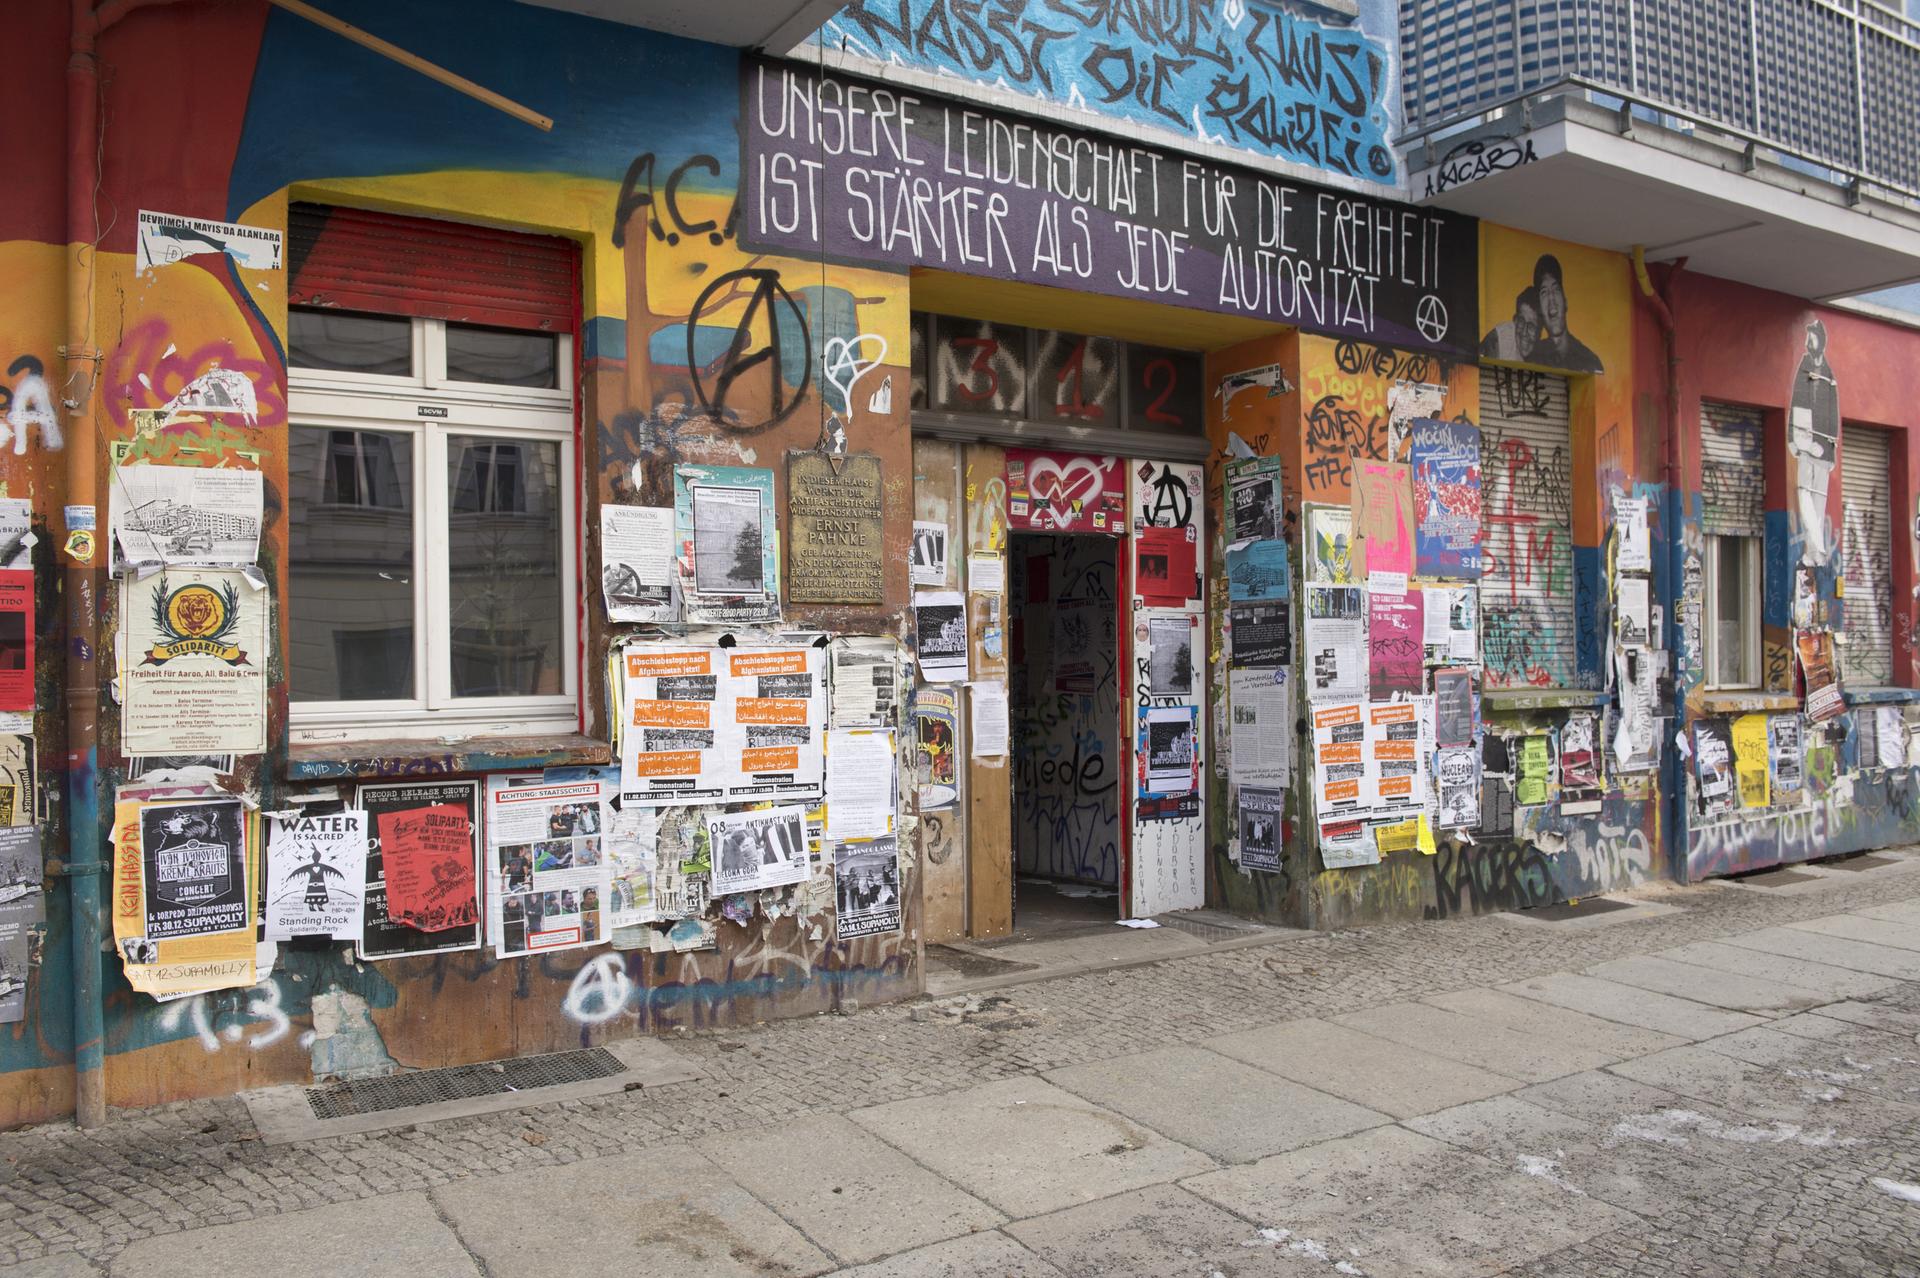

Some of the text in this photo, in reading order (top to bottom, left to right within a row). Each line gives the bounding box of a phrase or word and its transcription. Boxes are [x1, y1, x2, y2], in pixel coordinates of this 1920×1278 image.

[758, 65, 1446, 290] UNSERE LEIDENSCHAFT FÜR DIE FREIHEIT
[236, 226, 280, 242] ALANLARA
[759, 152, 1380, 335] IST STÄRKER ALS JEDE AUTORITÄT
[1143, 358, 1184, 425] 2
[797, 475, 807, 485] IN
[844, 477, 873, 487] HAUSE
[816, 519, 859, 532] ERNST
[808, 532, 866, 546] PAHNKE
[792, 559, 882, 570] VON DEN FASCHISTEN
[791, 568, 834, 577] ERMORDET
[166, 640, 229, 657] SOLIDARITY
[632, 656, 687, 666] Abschiebestopp
[734, 656, 785, 666] Abschiebestopp
[131, 670, 162, 678] Freiheit
[219, 669, 235, 677] Balu
[639, 667, 681, 677] Afghanistan
[741, 667, 779, 675] Afghanistan
[302, 764, 330, 775] DAVID
[649, 781, 694, 790] Demonstration
[366, 787, 470, 799] RECORD RELEASE SHOWS
[501, 791, 537, 801] ACHTUNG:
[539, 786, 591, 797] STAATSSCHUTZ
[677, 791, 712, 799] Brandenburger
[279, 817, 358, 832] WATER
[425, 814, 466, 830] SOLIPARTY
[711, 821, 726, 834] 08
[293, 833, 302, 841] IS
[194, 863, 225, 877] KRAUTS
[178, 884, 214, 896] CONCERT
[148, 922, 161, 933] FR
[184, 912, 244, 928] SUPAMOLLY
[149, 913, 154, 921] &
[279, 915, 348, 927] Standing Rock
[860, 916, 900, 930] SUPAMOLLY
[173, 962, 247, 980] SUPAMOLLY
